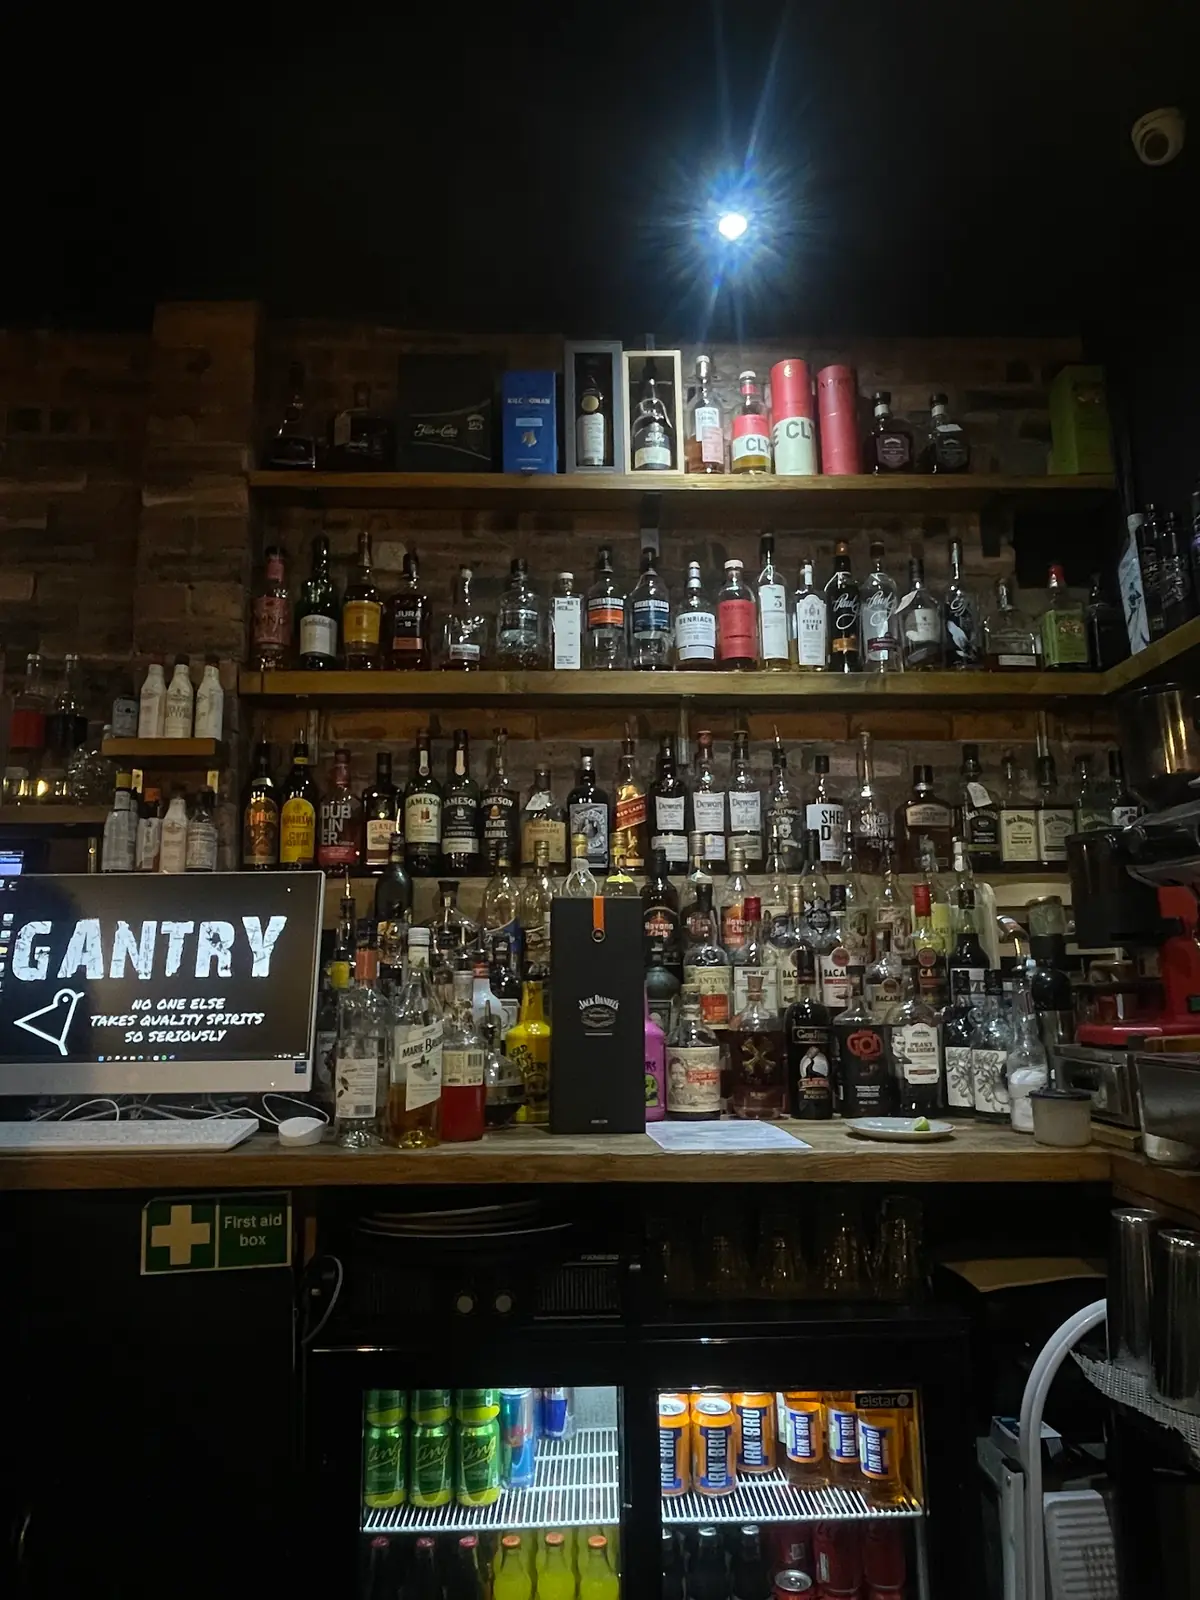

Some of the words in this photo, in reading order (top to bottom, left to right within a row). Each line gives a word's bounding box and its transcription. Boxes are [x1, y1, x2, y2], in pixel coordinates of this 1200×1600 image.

[395, 609, 422, 619] JURA
[678, 613, 713, 624] BENRIACH
[321, 803, 351, 819] DUB
[322, 819, 343, 832] LIN
[11, 915, 288, 981] GANTRY
[131, 999, 152, 1011] NO
[157, 998, 186, 1010] ONE
[191, 997, 226, 1010] ELSE
[578, 997, 595, 1011] JACK
[594, 994, 620, 1011] DANIEL'S
[90, 1014, 137, 1027] TAKES
[139, 1013, 202, 1027] QUALITY
[206, 1012, 265, 1026] SPIRITS
[124, 1031, 143, 1043] SO
[148, 1029, 228, 1043] SERIOUSLY
[224, 1215, 256, 1229] First
[259, 1213, 282, 1227] aid
[239, 1234, 267, 1247] box
[859, 1394, 897, 1408] elstar
